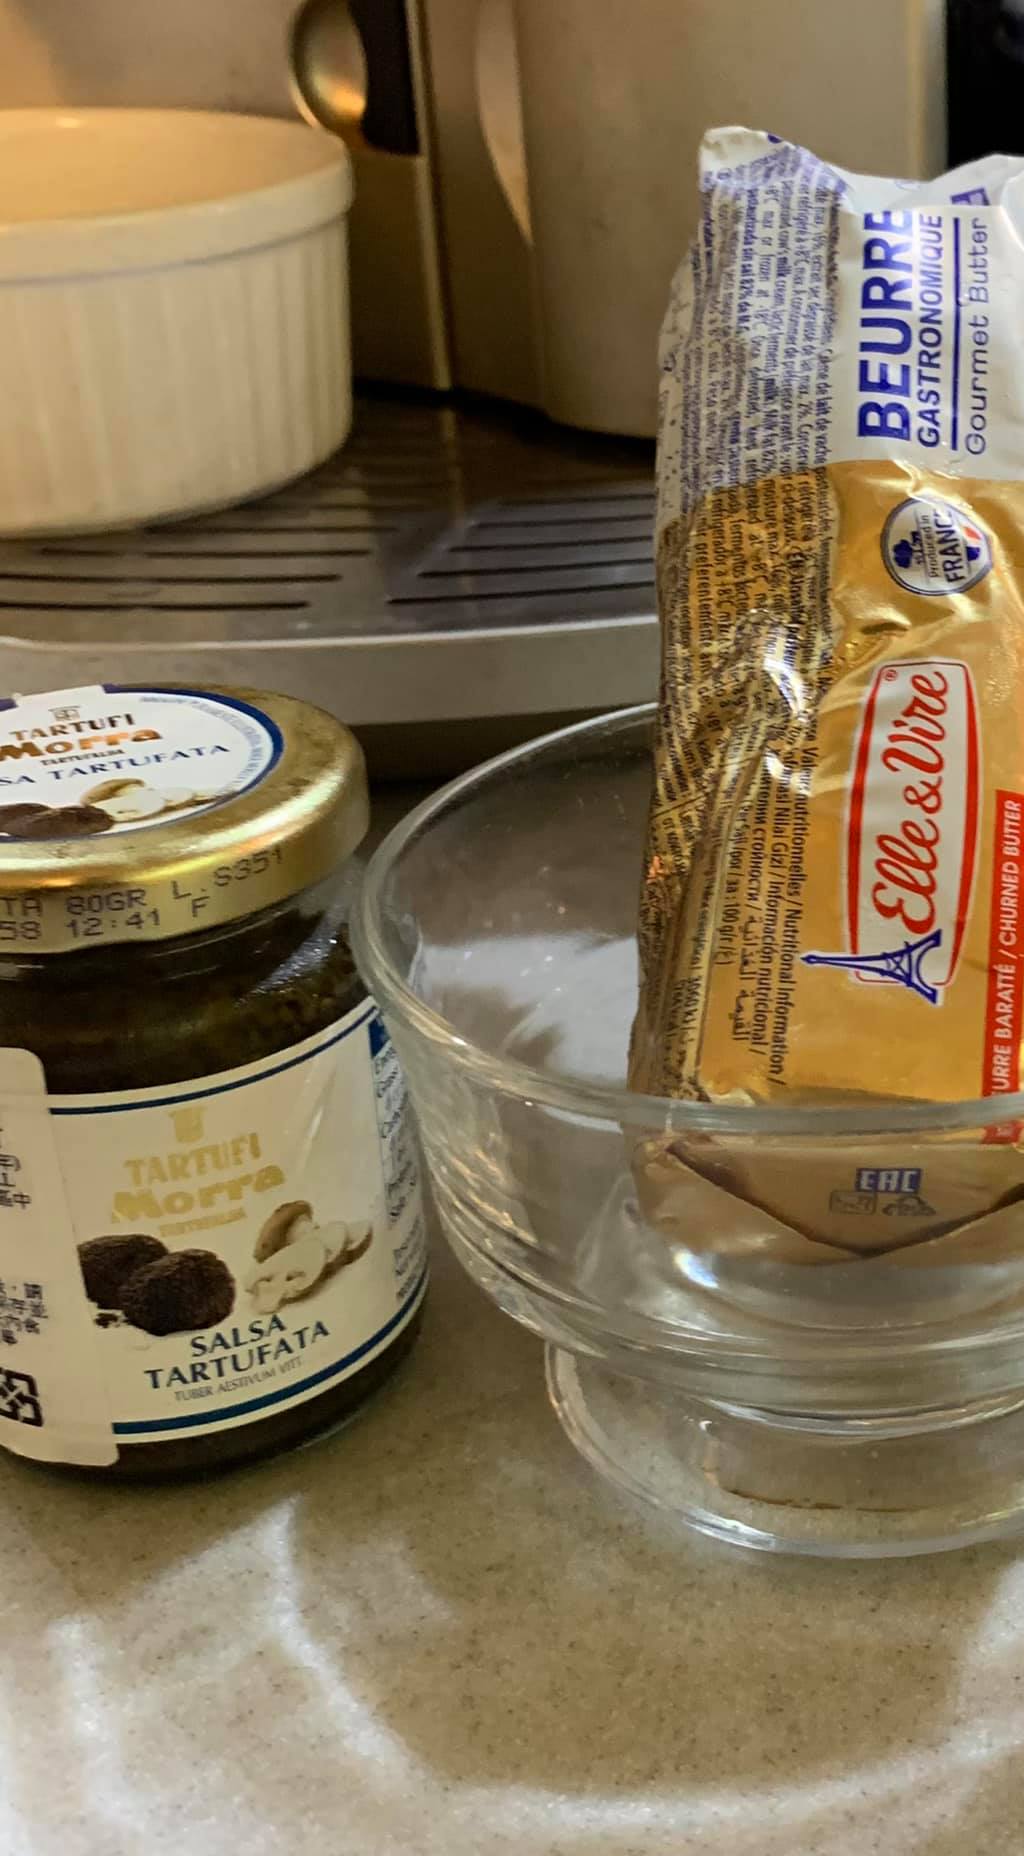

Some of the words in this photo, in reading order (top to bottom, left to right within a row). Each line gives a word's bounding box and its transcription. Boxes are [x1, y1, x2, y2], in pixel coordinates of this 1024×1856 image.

[966, 217, 989, 304] Butter
[857, 209, 912, 441] BEURRE
[917, 213, 942, 448] GASTRONOMIQUE
[963, 315, 988, 456] Gourmet
[0, 729, 163, 762] Morra
[10, 713, 136, 742] TARTUFI
[48, 745, 231, 781] TARTUFATA
[787, 793, 811, 896] nutritionnelles
[1002, 799, 1022, 857] BUTTER
[65, 908, 162, 938] 12:41
[998, 861, 1020, 946] CHURNED
[779, 908, 803, 984] Nutritional
[751, 967, 774, 1046] nutricional
[769, 987, 796, 1075] Information
[991, 963, 1017, 1040] BARATTÉ
[112, 1165, 286, 1224] Morra
[123, 1133, 262, 1187] TARTUFI
[144, 1321, 330, 1389] TARTUFATA
[190, 1314, 286, 1357] SALSA
